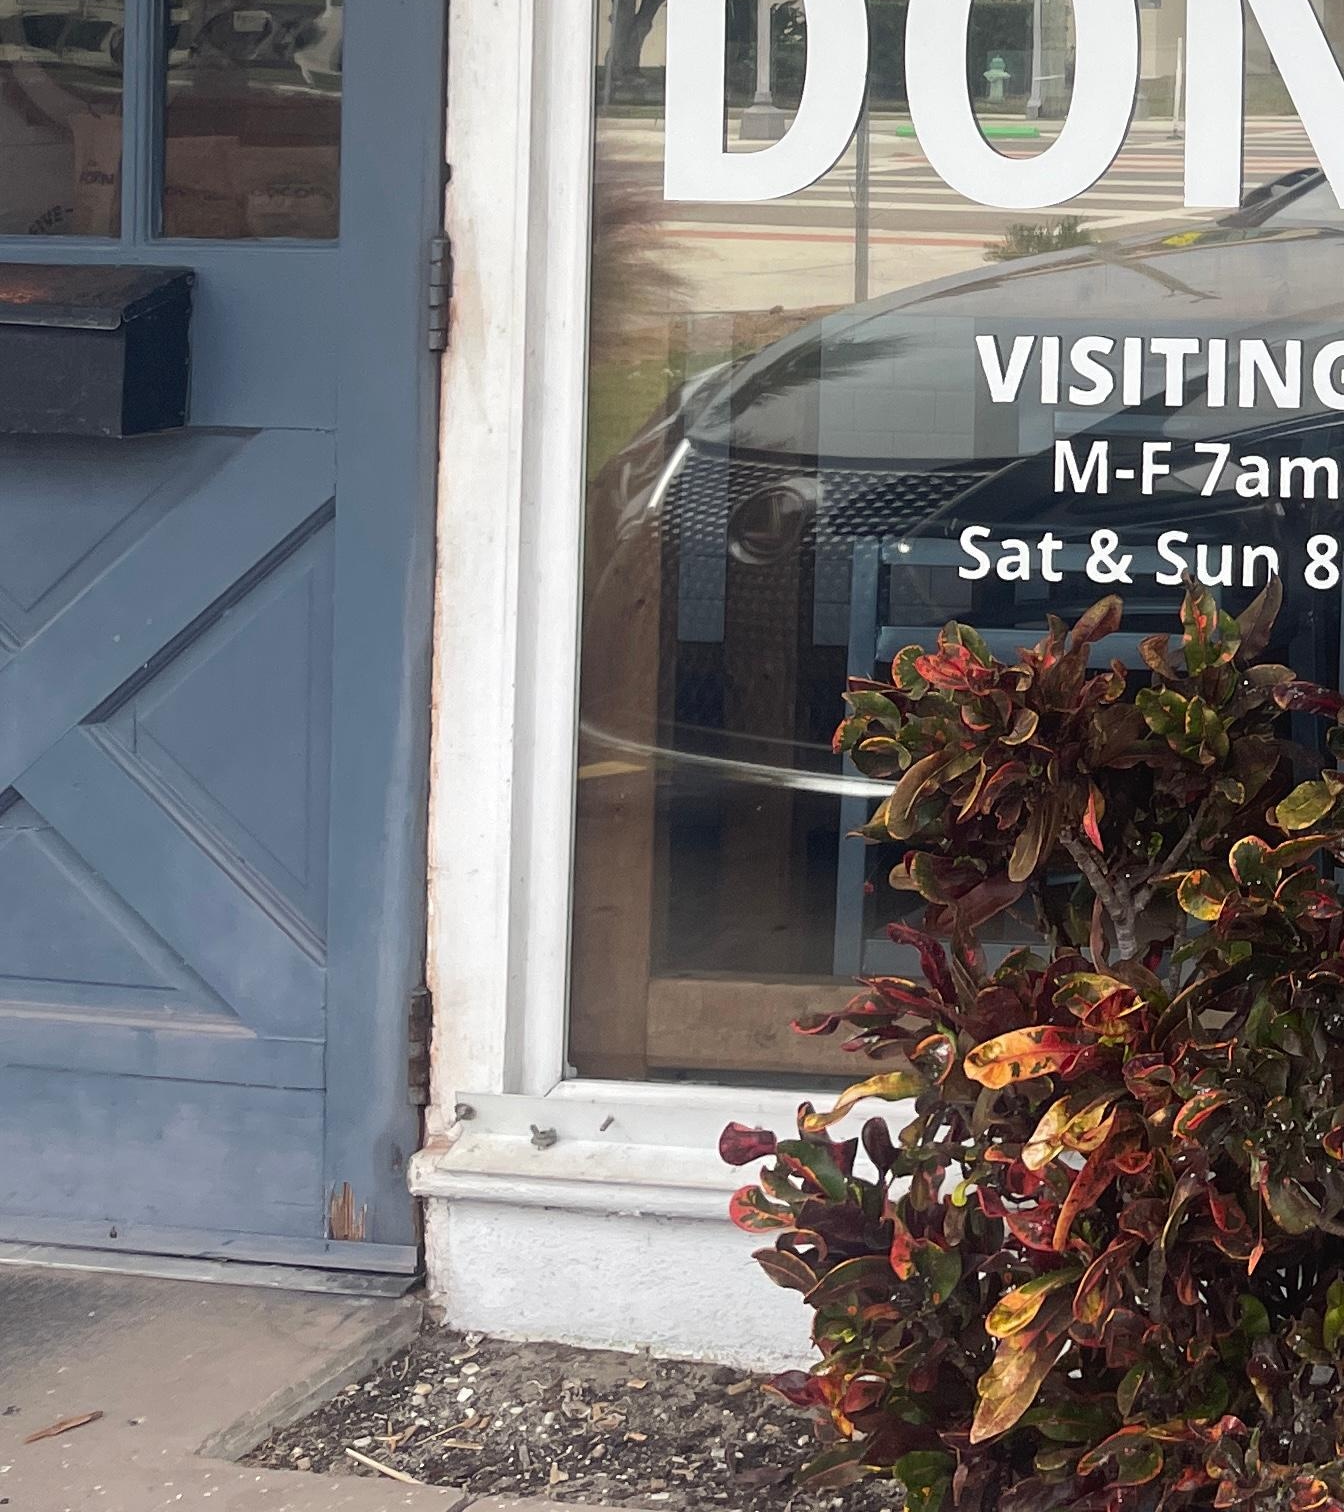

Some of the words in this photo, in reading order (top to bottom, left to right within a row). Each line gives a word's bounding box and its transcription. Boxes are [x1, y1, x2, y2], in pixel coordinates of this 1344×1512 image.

[1052, 440, 1173, 496] M-F
[957, 525, 1063, 583] Sat
[1085, 530, 1135, 587] &
[1154, 531, 1281, 590] Sun
